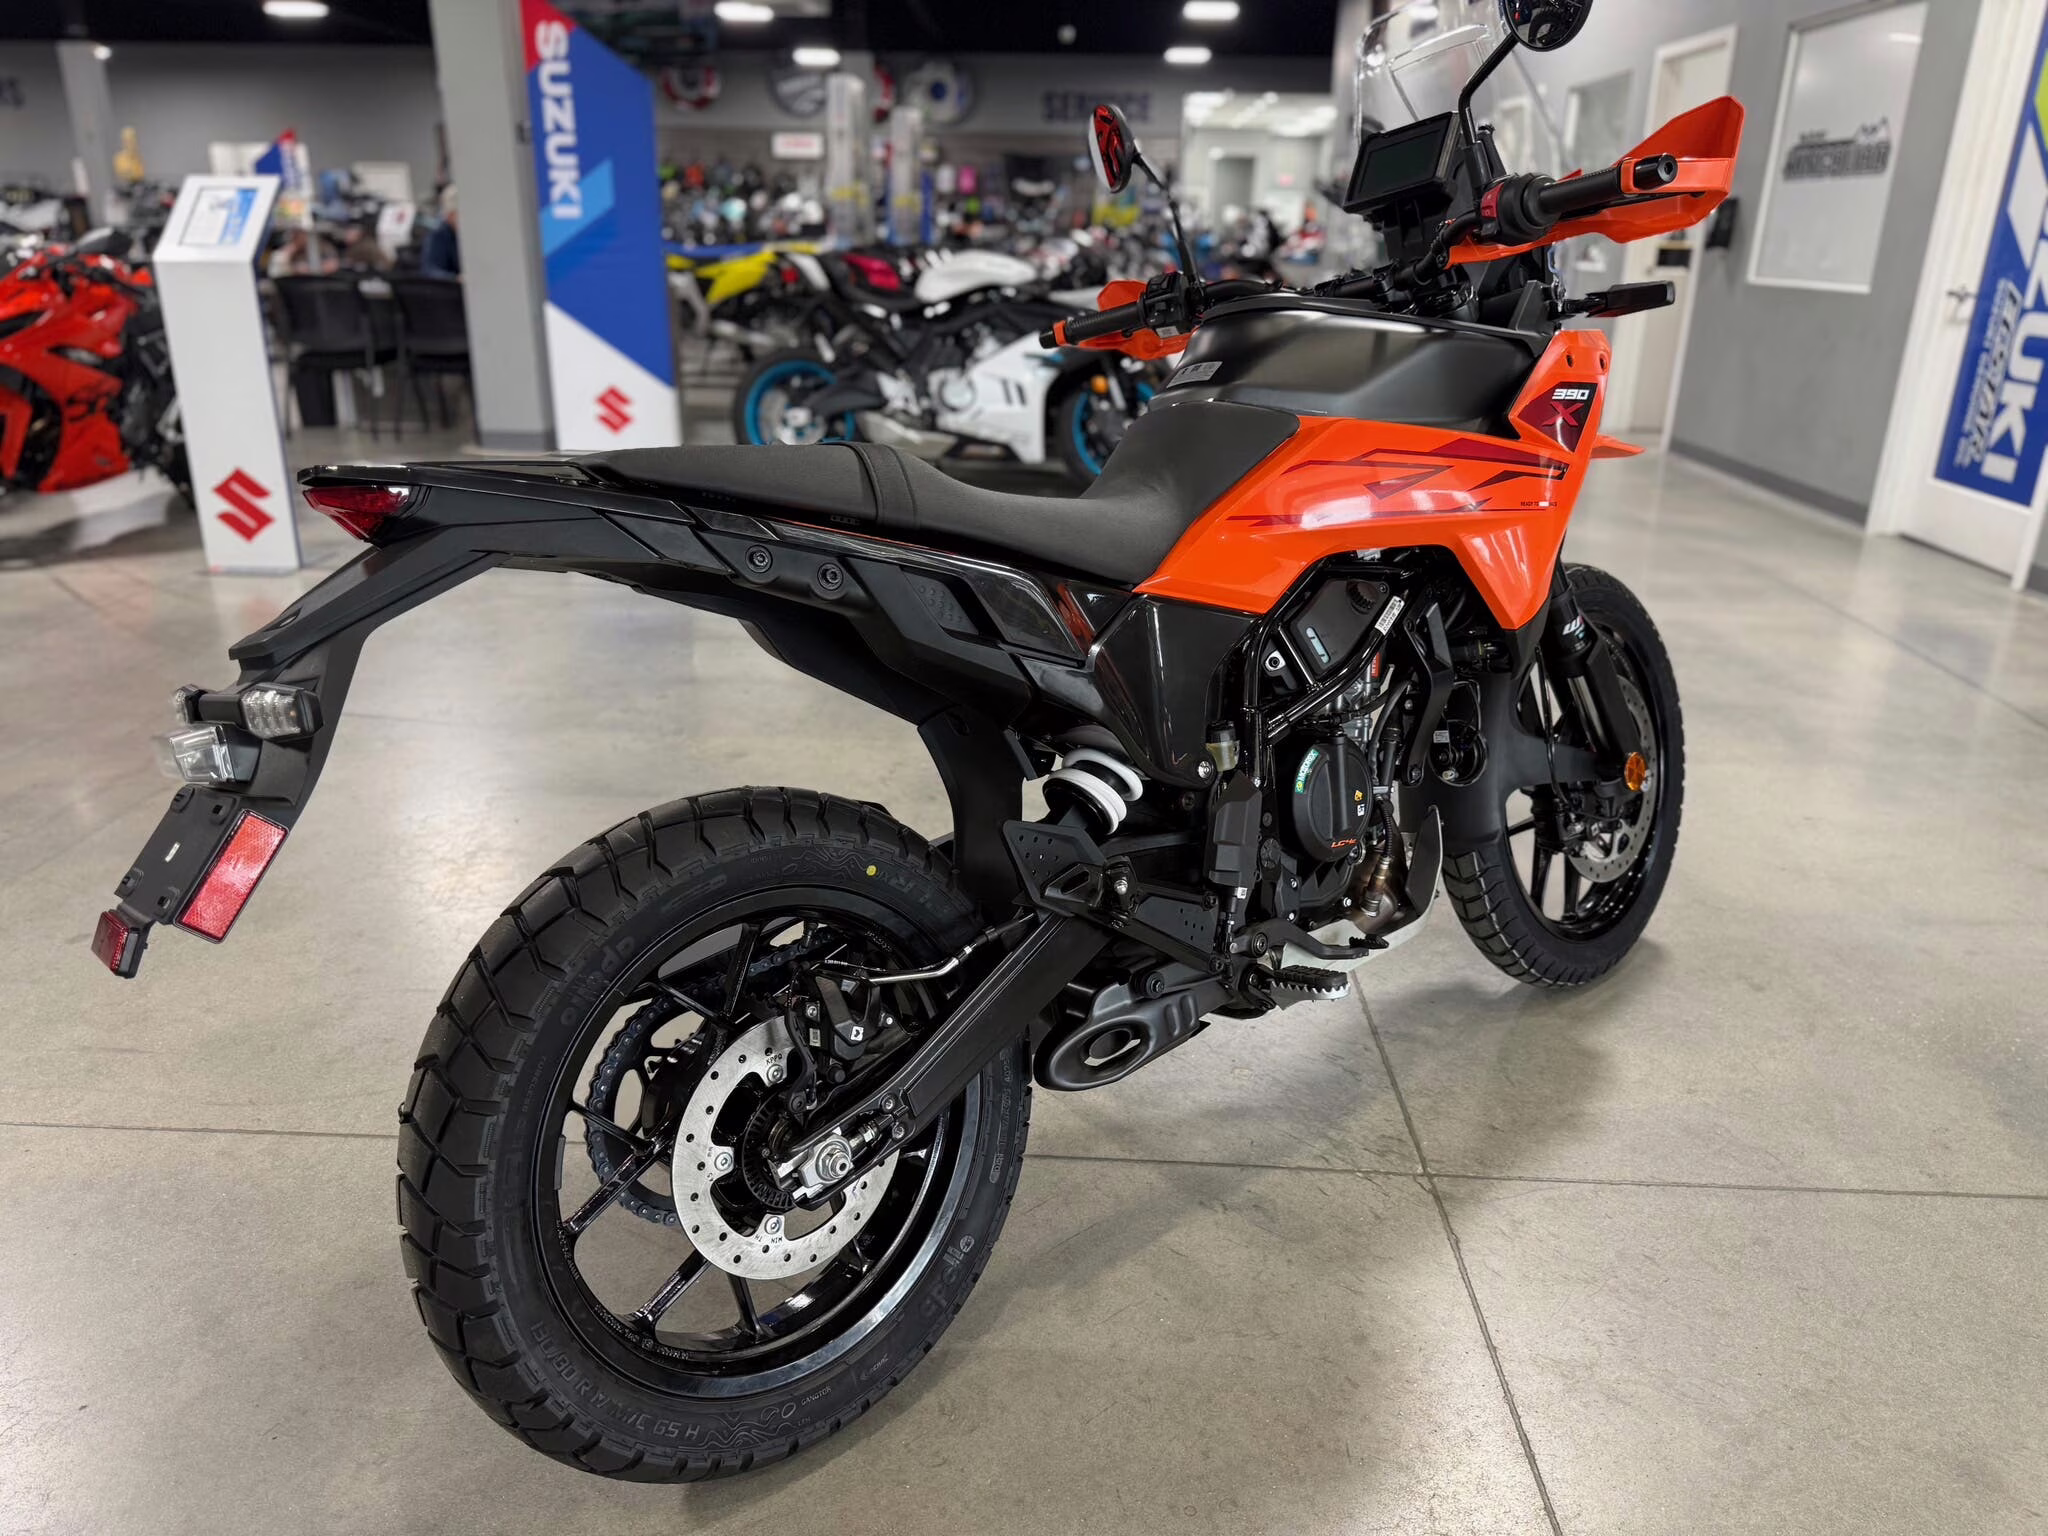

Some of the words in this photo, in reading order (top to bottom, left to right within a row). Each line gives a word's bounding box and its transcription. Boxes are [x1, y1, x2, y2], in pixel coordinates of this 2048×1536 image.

[535, 20, 583, 220] SUZUKI
[1552, 388, 1590, 400] 390
[1541, 401, 1584, 427] X
